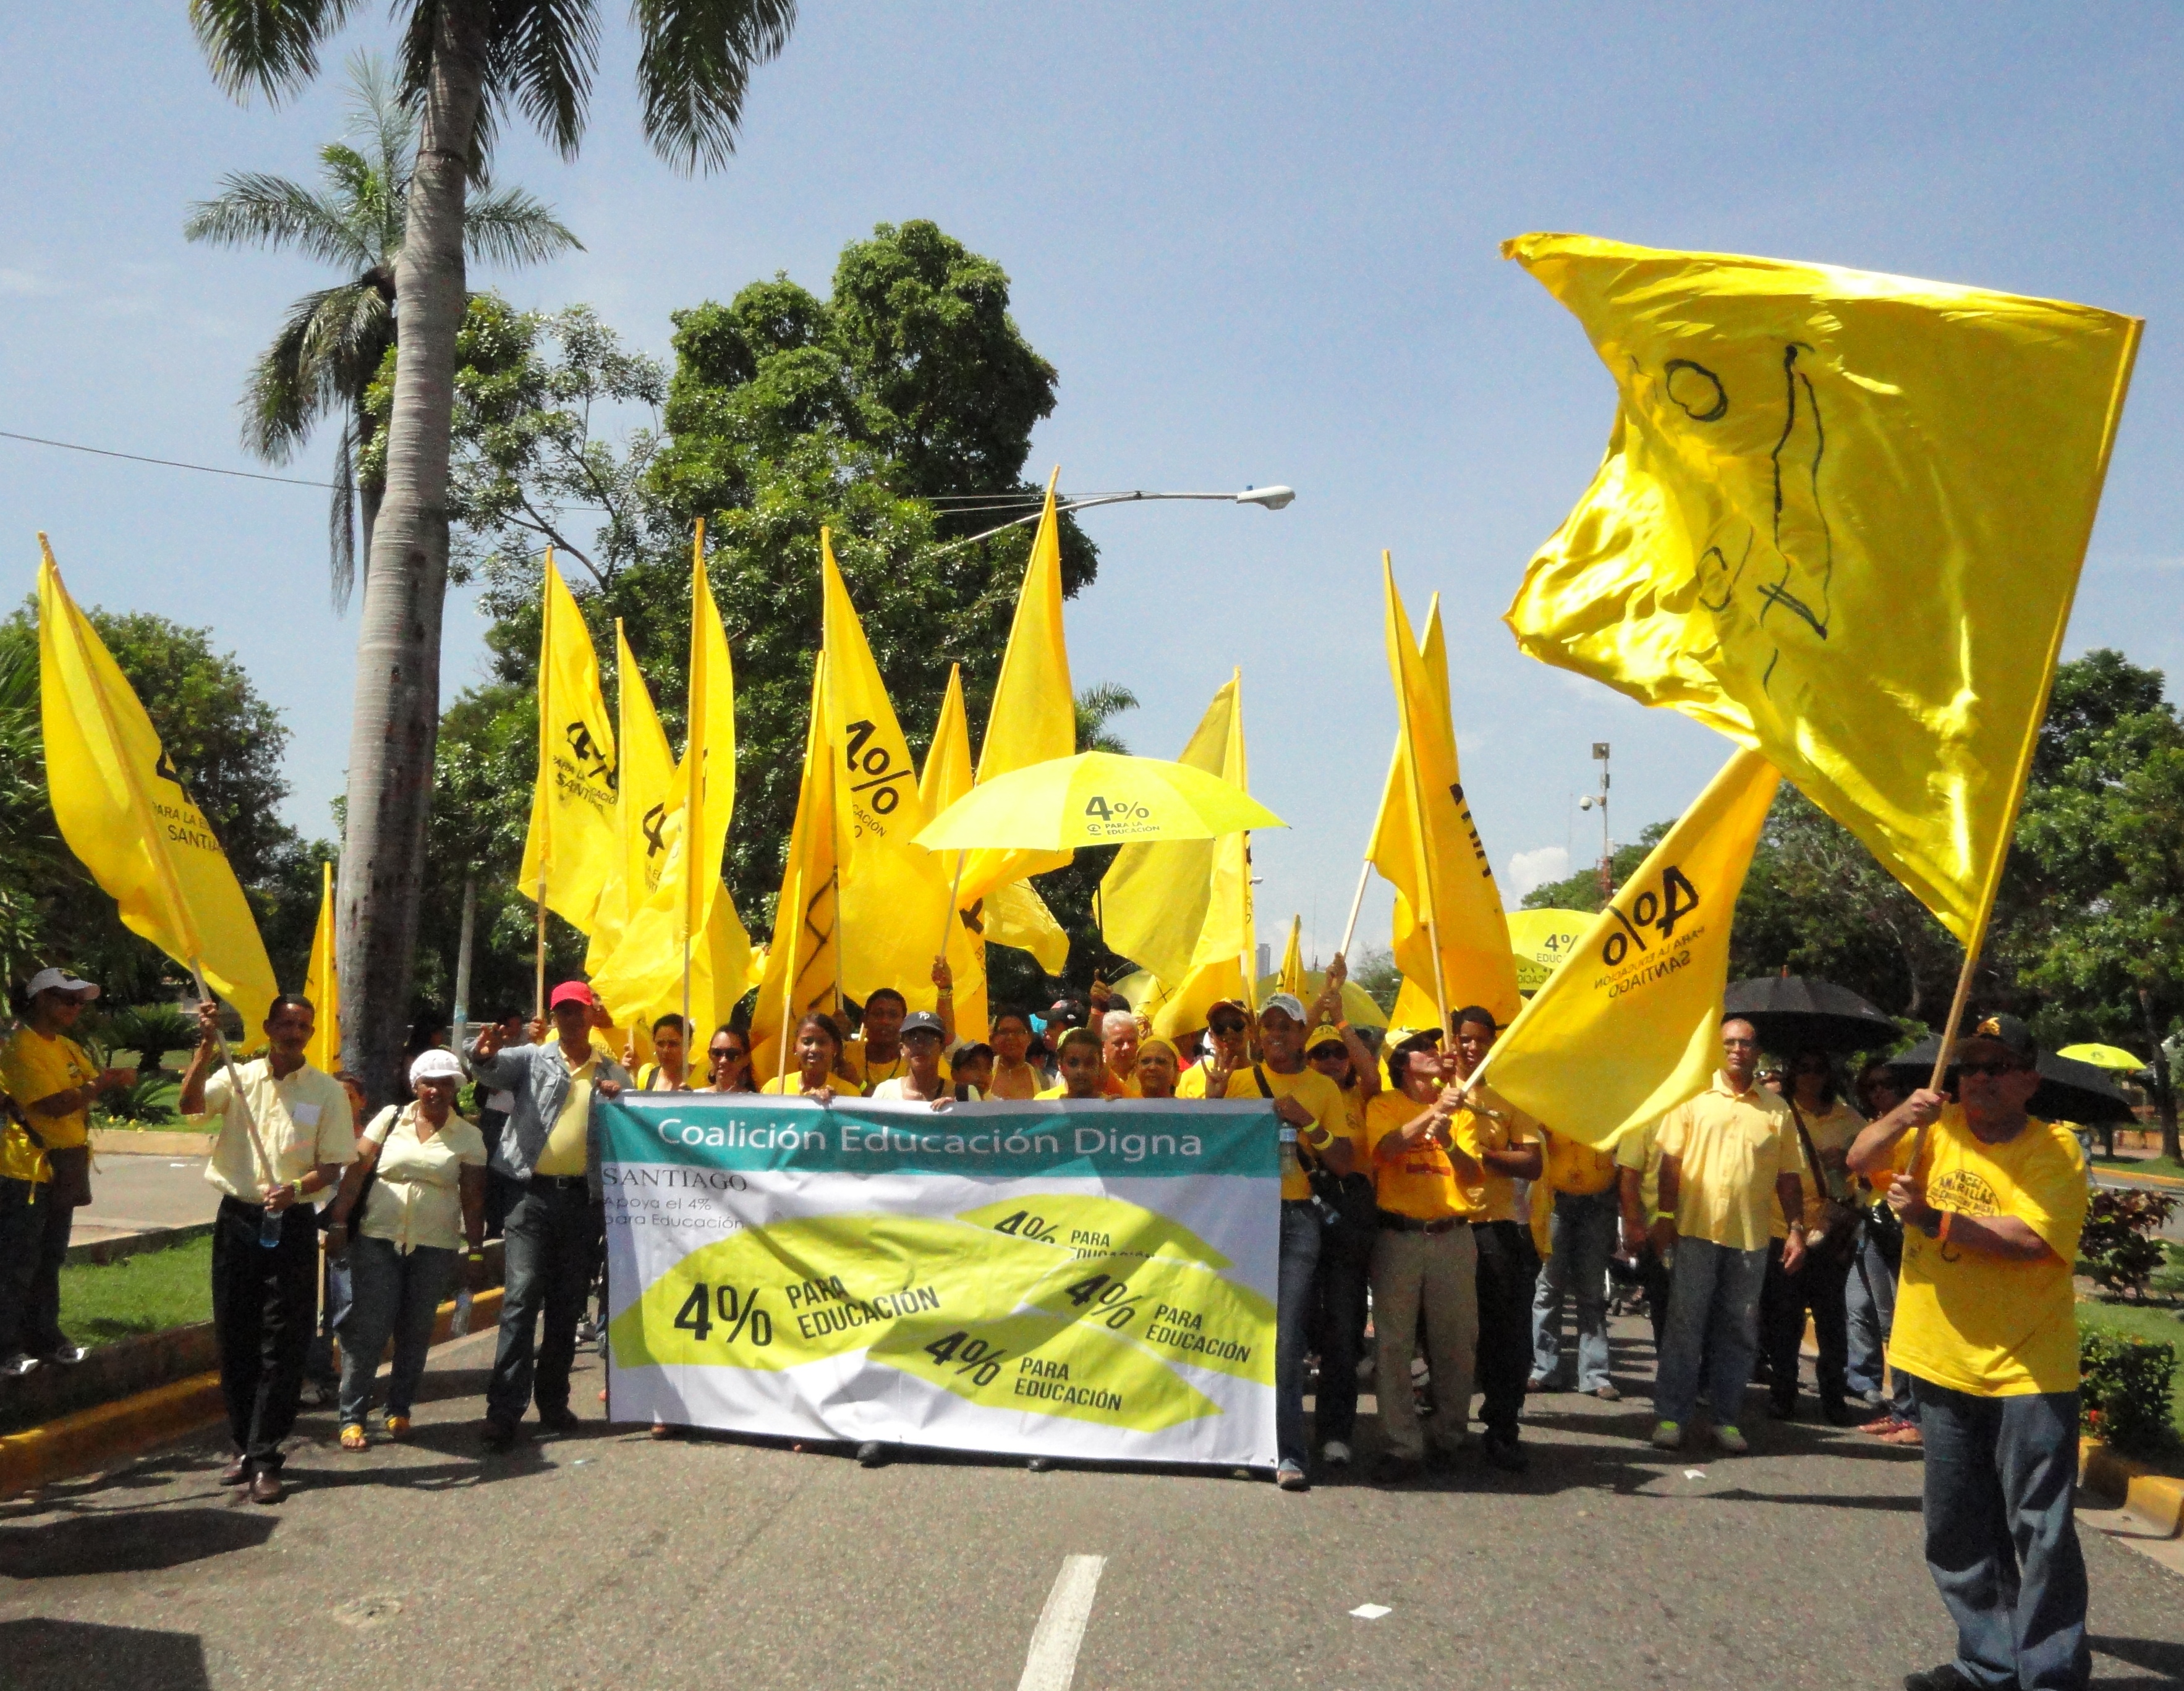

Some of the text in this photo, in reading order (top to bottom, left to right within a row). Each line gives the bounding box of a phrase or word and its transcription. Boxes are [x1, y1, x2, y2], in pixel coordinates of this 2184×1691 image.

[1085, 796, 1150, 821] 4%
[1107, 826, 1160, 836] EDUCACIÓN
[1536, 953, 1564, 964] EDUC
[658, 1118, 1203, 1163] Coalición Educación Digna
[602, 1167, 747, 1192] SANTIAGO
[604, 1197, 711, 1211] Apoya el 4%
[652, 1214, 744, 1229] Educación
[1070, 1229, 1110, 1247] PARA
[785, 1274, 850, 1310] PARA
[1064, 1274, 1143, 1330] 4%
[674, 1282, 773, 1347] 4%
[797, 1286, 941, 1339] EDUCACIÓN
[1154, 1303, 1203, 1331] PARA
[1145, 1324, 1252, 1363] EDUCACIÓN
[924, 1331, 1008, 1387] 4%
[1019, 1356, 1069, 1380] PARA
[1014, 1378, 1122, 1412] EDUCACIÓN
